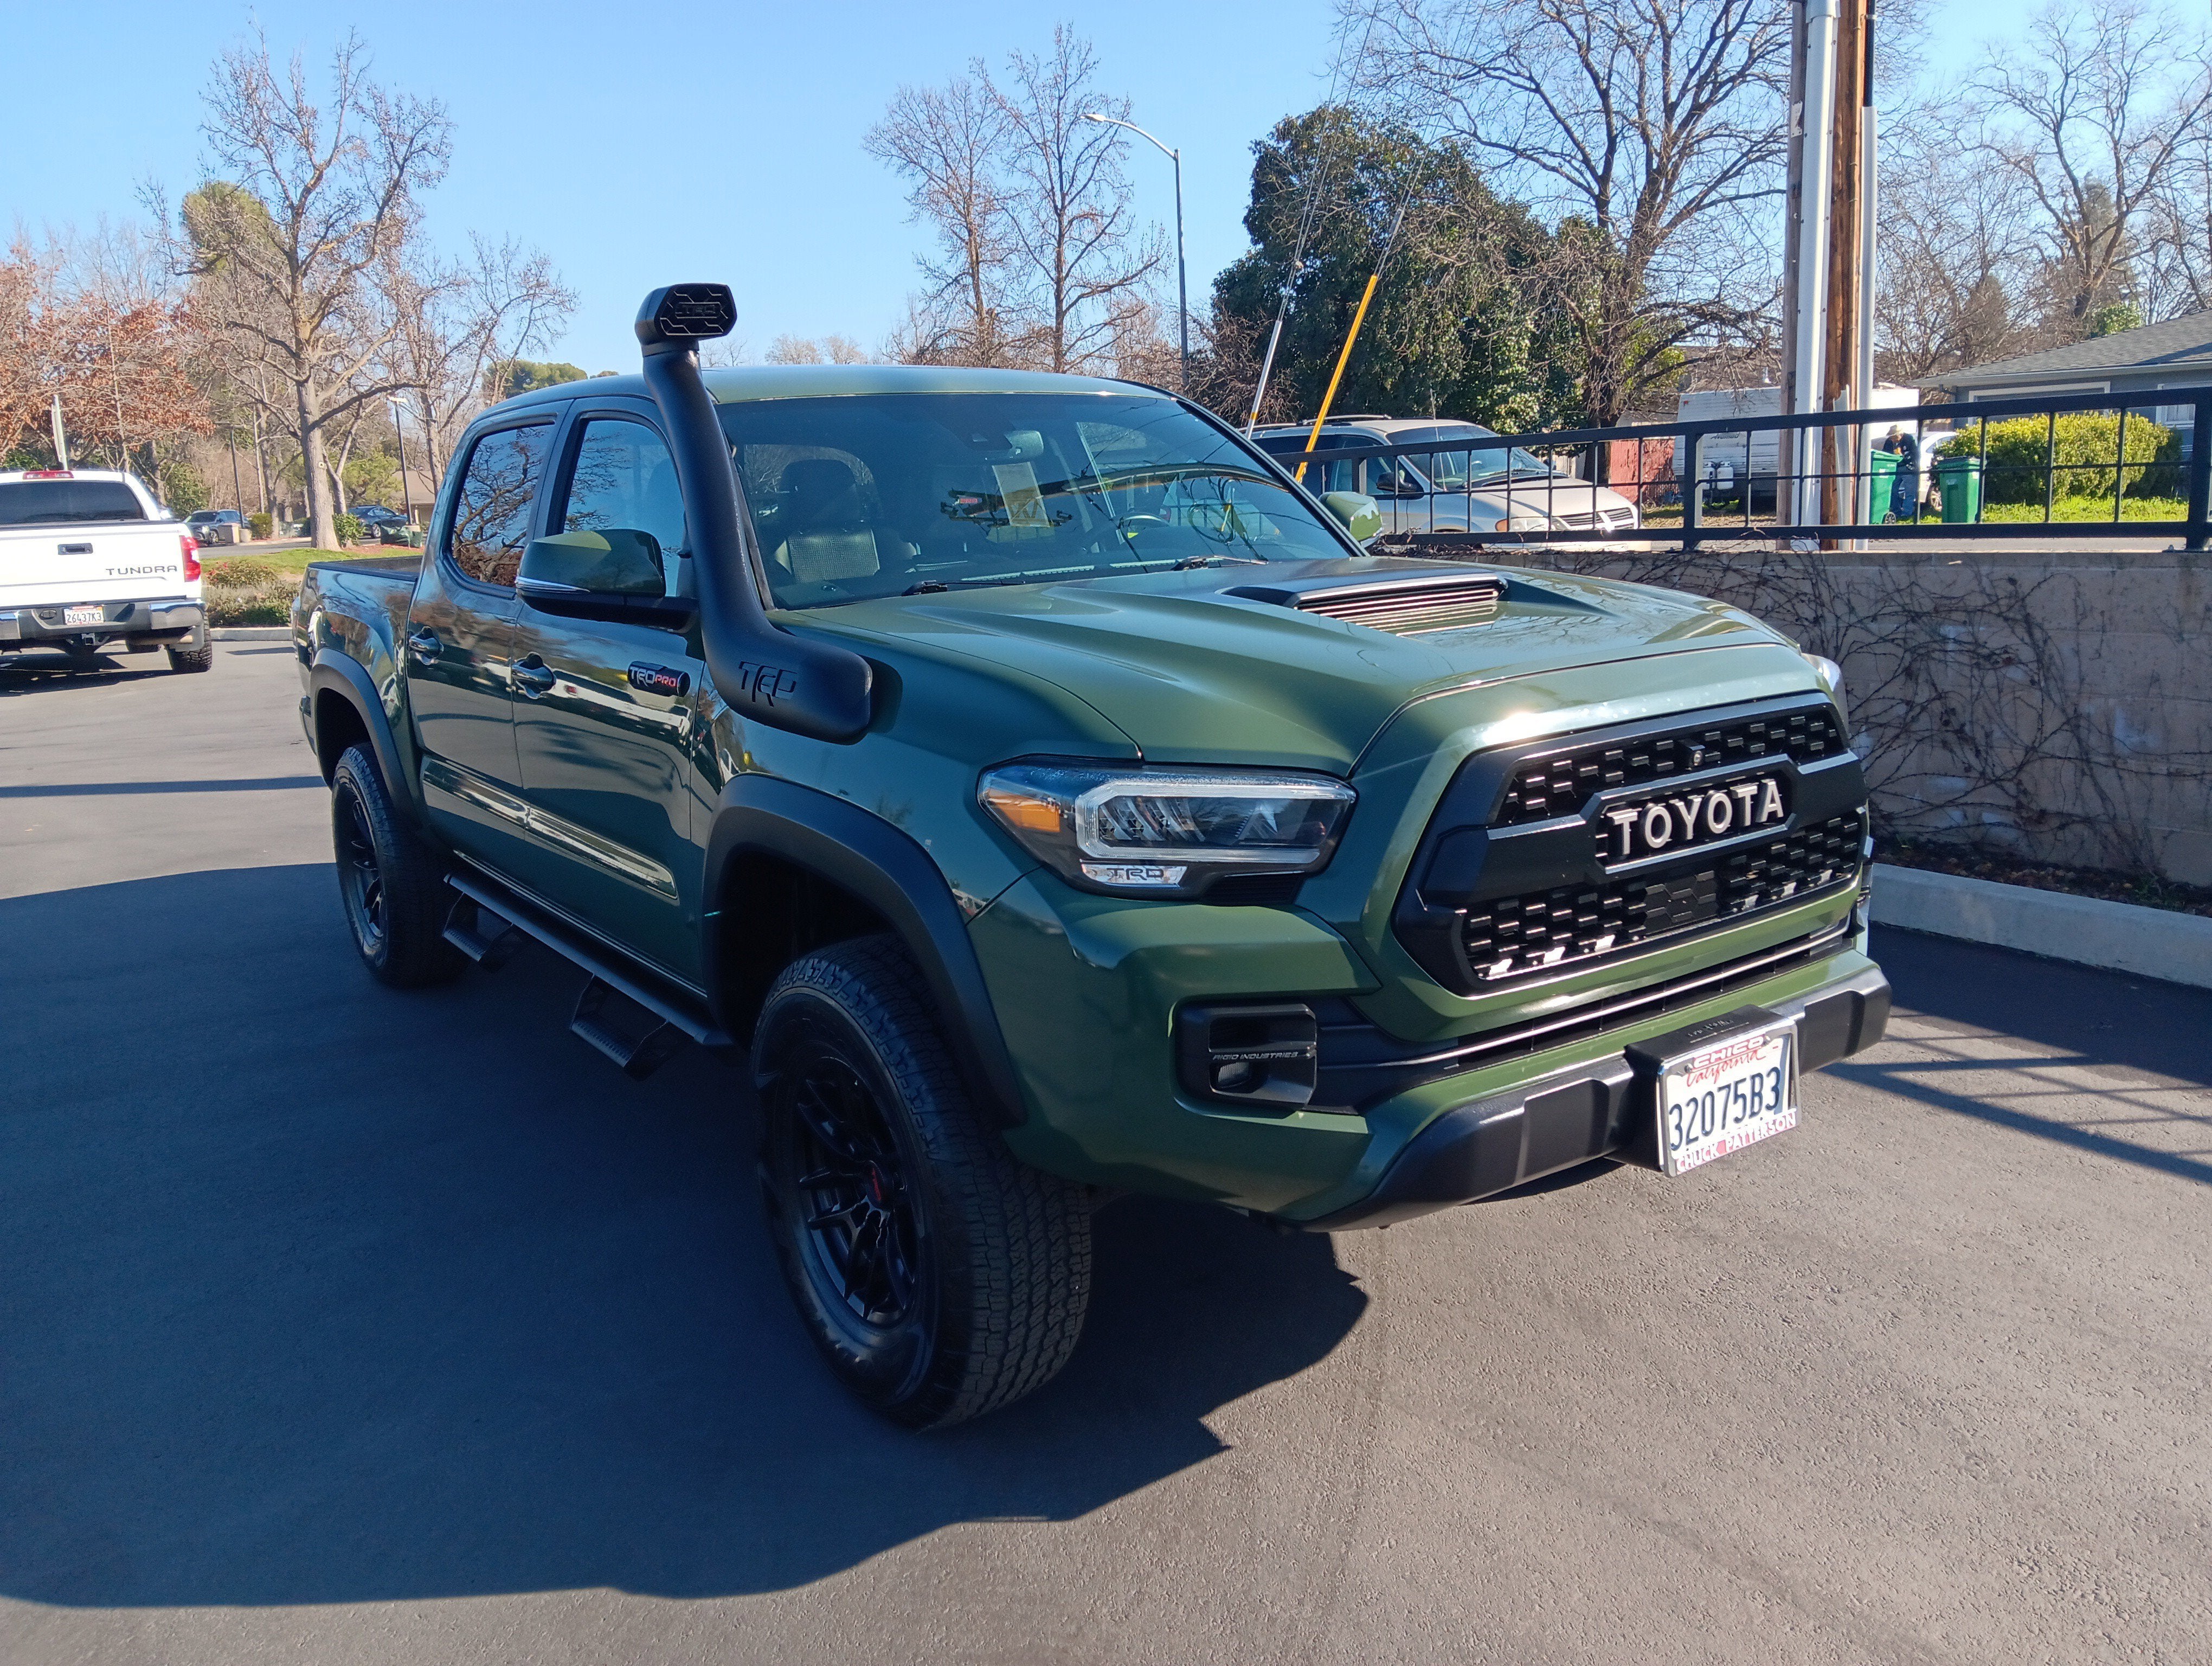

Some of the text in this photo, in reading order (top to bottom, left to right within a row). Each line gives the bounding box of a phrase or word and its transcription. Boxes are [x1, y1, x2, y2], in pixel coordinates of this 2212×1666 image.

[105, 565, 177, 575] TUNDRA
[67, 612, 101, 623] 26437K3
[629, 667, 678, 687] TRD PRO
[738, 661, 799, 707] TRD
[1609, 779, 1784, 855] TOYOTA
[1107, 868, 1164, 881] TRD
[1693, 1036, 1764, 1068] CHICO
[1669, 1066, 1781, 1151] 32075B3
[1676, 1112, 1796, 1172] CHUCK PATTERSON
